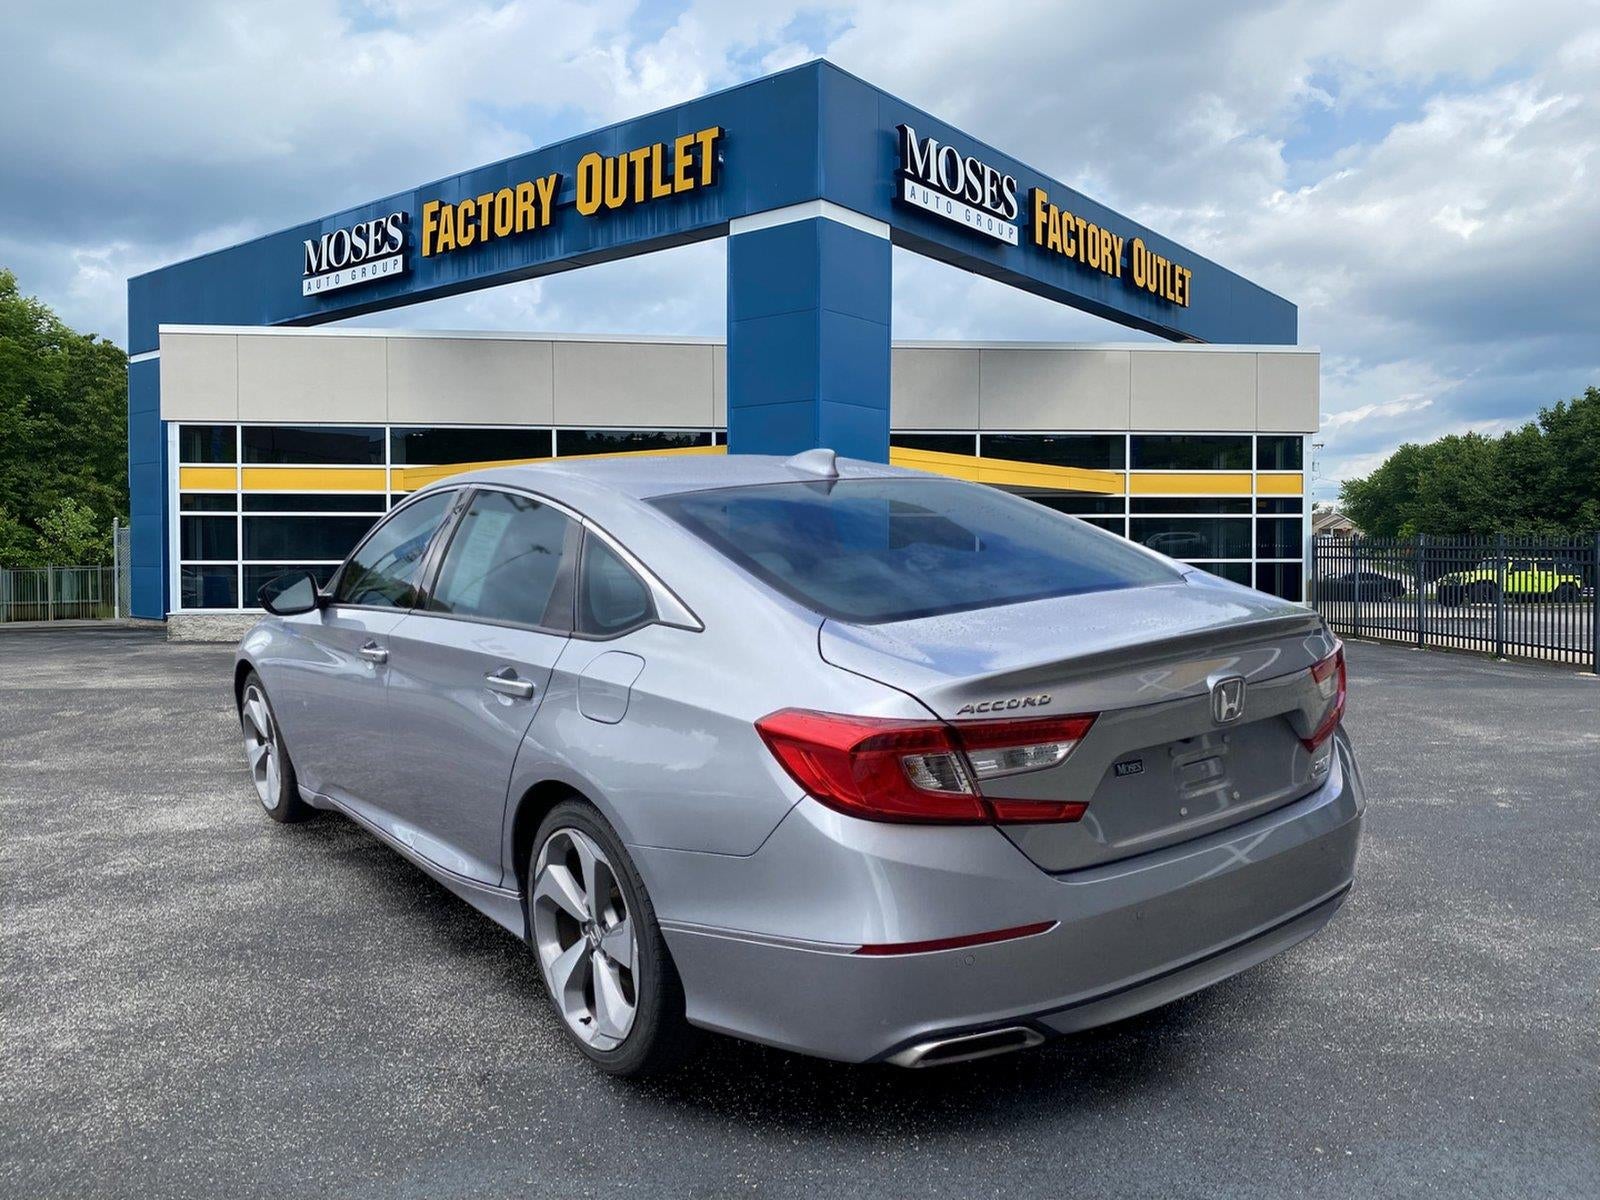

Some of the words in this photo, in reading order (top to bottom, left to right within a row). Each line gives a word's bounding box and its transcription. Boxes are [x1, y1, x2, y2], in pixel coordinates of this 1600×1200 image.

[421, 173, 559, 257] FACTORY
[576, 126, 720, 216] OUTLET
[904, 124, 1018, 220] MOSES
[303, 211, 403, 276] MOSES
[910, 185, 953, 215] AUTO
[965, 209, 1014, 240] GROUP
[307, 274, 340, 292] AUTO
[351, 258, 399, 281] GROUP
[1034, 187, 1124, 278] FACTORY
[1131, 237, 1192, 307] OUTLET
[957, 694, 1052, 715] ACCORD
